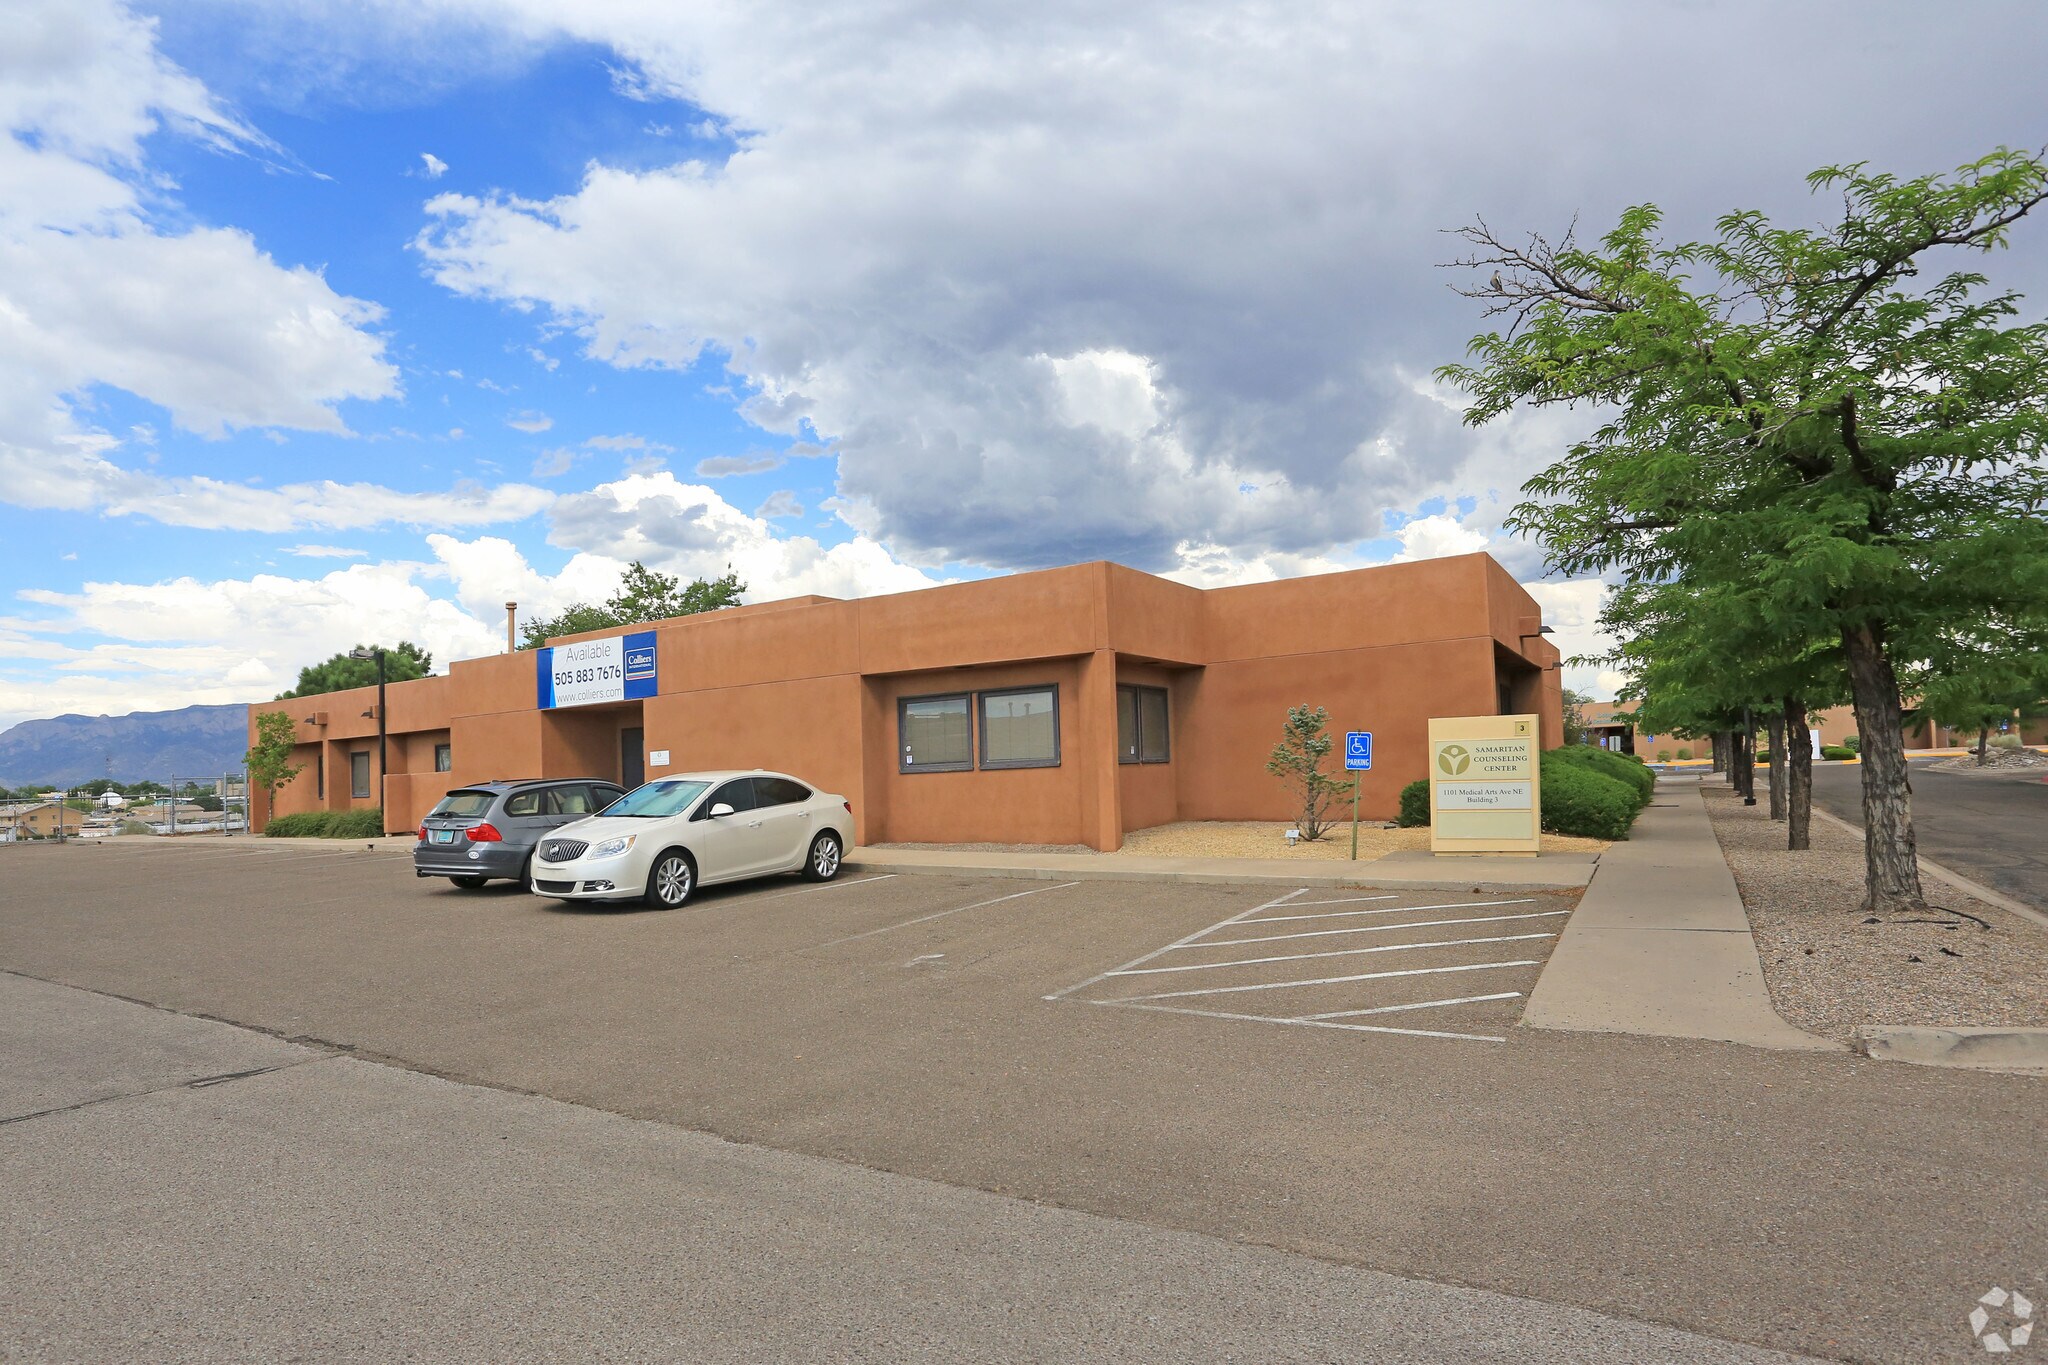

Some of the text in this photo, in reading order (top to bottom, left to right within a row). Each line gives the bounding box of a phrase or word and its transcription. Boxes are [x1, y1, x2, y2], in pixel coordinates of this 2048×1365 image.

[566, 643, 611, 663] Available
[628, 655, 651, 664] Colliers
[555, 665, 621, 686] 505 883 7676
[557, 688, 621, 703] www.colliers.com
